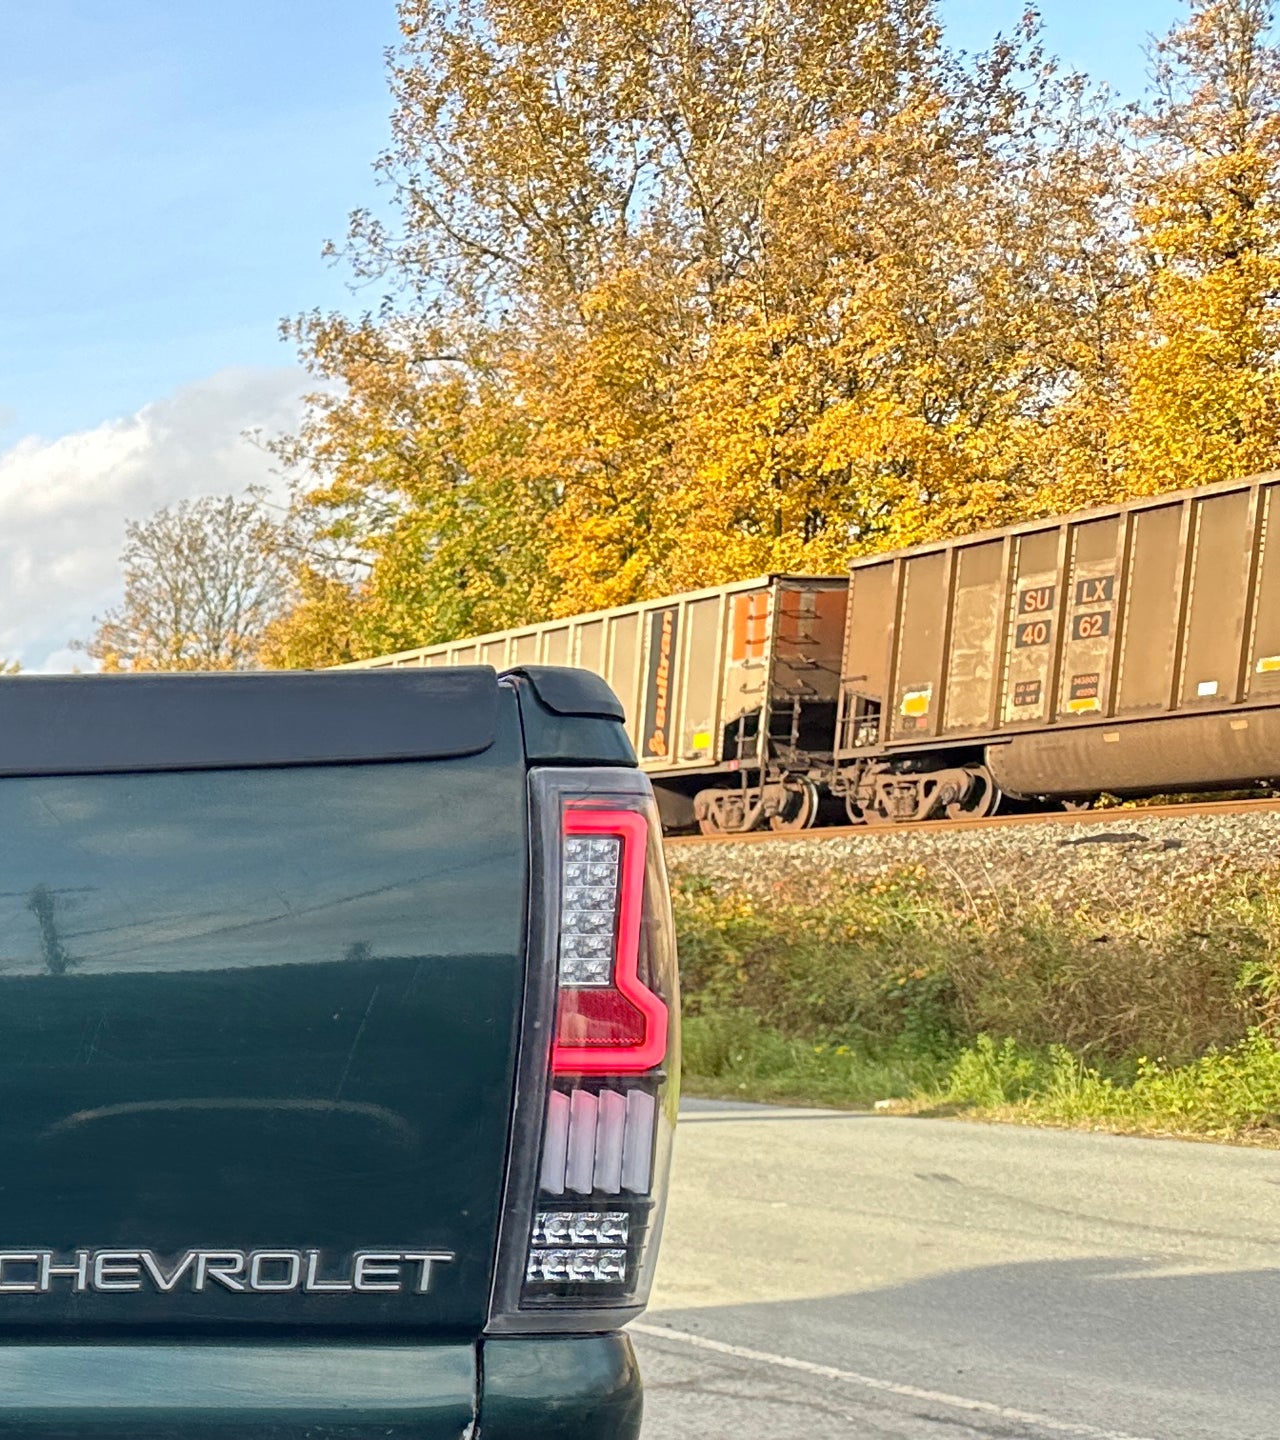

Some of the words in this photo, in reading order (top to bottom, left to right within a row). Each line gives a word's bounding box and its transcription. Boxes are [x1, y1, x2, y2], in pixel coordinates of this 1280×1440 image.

[1024, 589, 1050, 611] SU
[1082, 579, 1107, 603] LX
[1021, 622, 1047, 644] 40
[1079, 614, 1103, 638] 62
